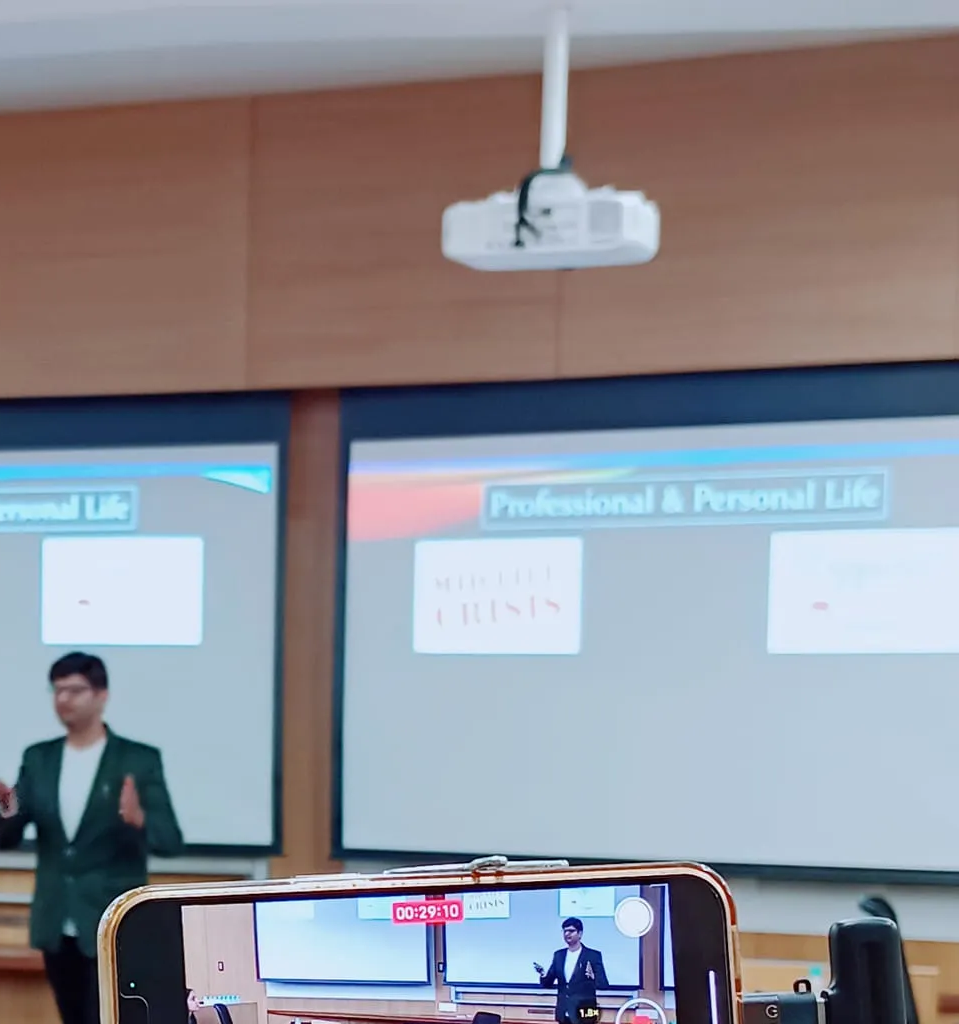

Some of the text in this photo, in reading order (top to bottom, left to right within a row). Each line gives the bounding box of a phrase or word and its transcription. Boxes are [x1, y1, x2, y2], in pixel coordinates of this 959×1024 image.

[84, 492, 131, 521] Life
[489, 476, 881, 519] Professional & Personal Life
[395, 903, 460, 921] 00:29:10
